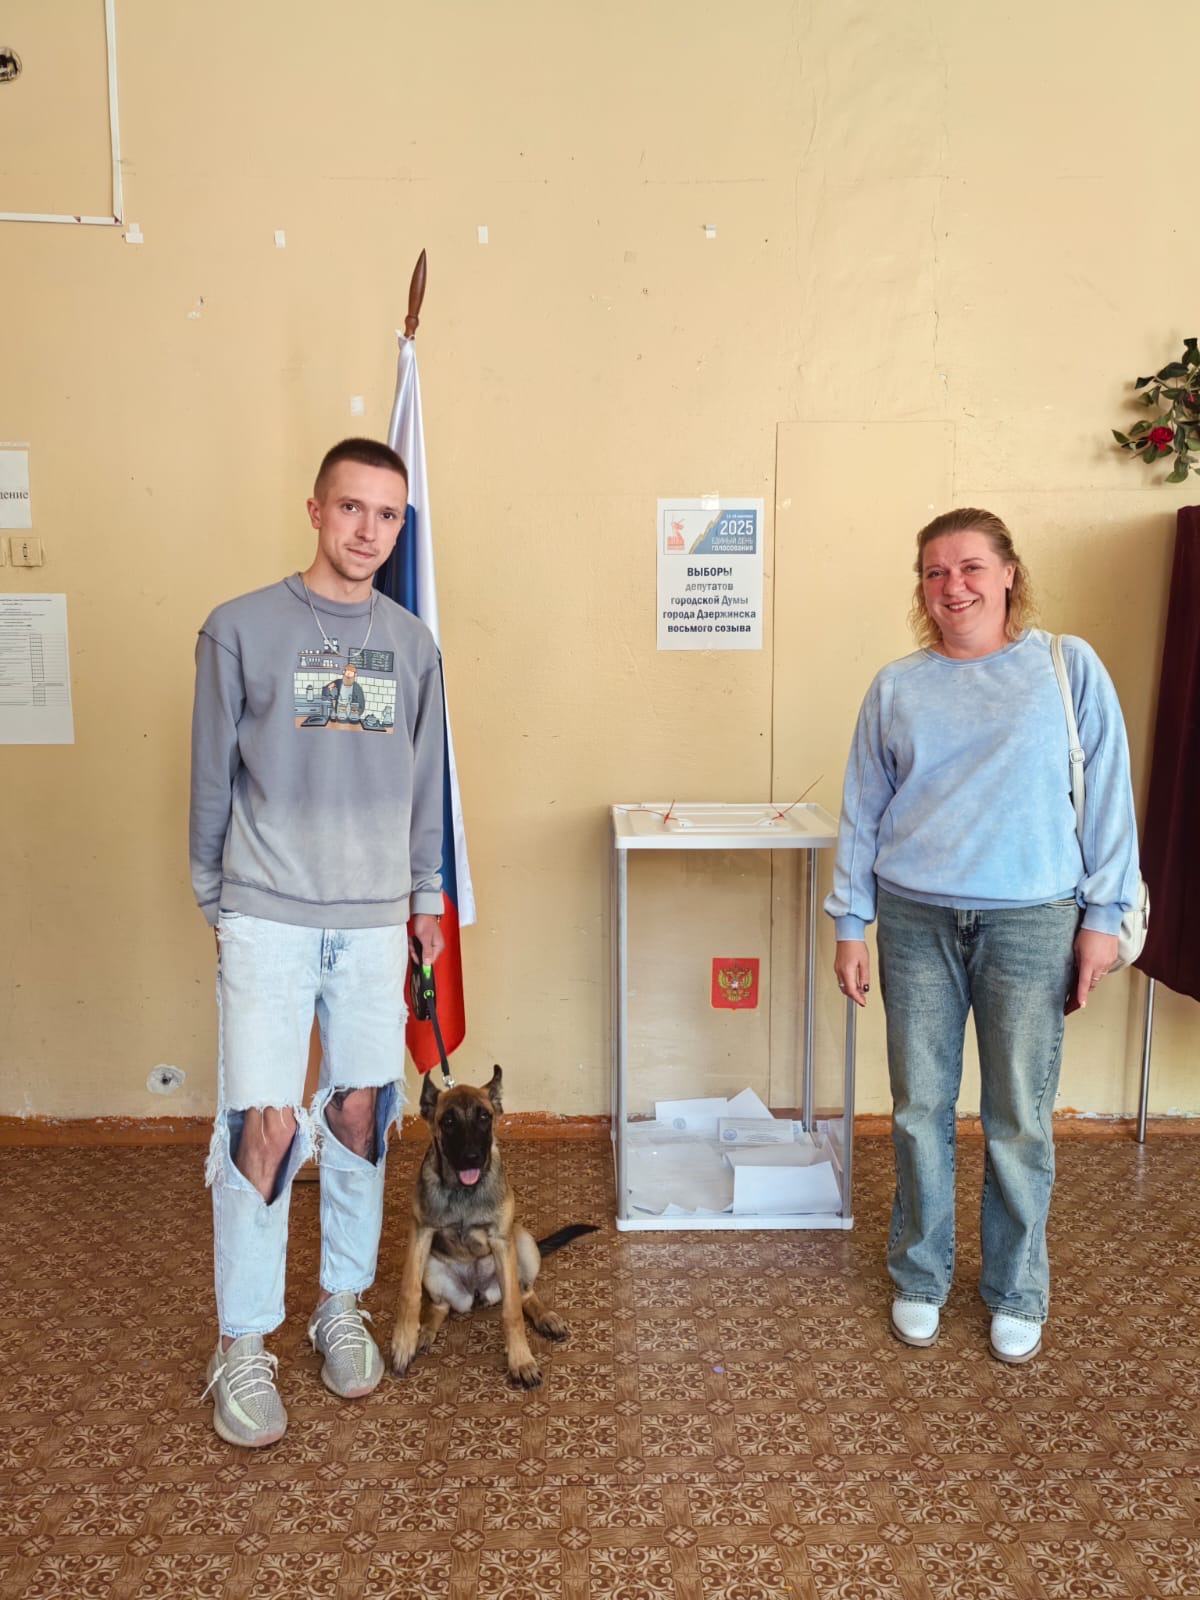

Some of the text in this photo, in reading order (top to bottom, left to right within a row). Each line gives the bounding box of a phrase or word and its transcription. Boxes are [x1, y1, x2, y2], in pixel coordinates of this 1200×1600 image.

[720, 519, 754, 536] 2025
[687, 567, 732, 577] ВЫБОРЫ
[685, 583, 734, 592] депутатов
[670, 595, 749, 606] городской Думы
[662, 609, 756, 620] города Дзержинска
